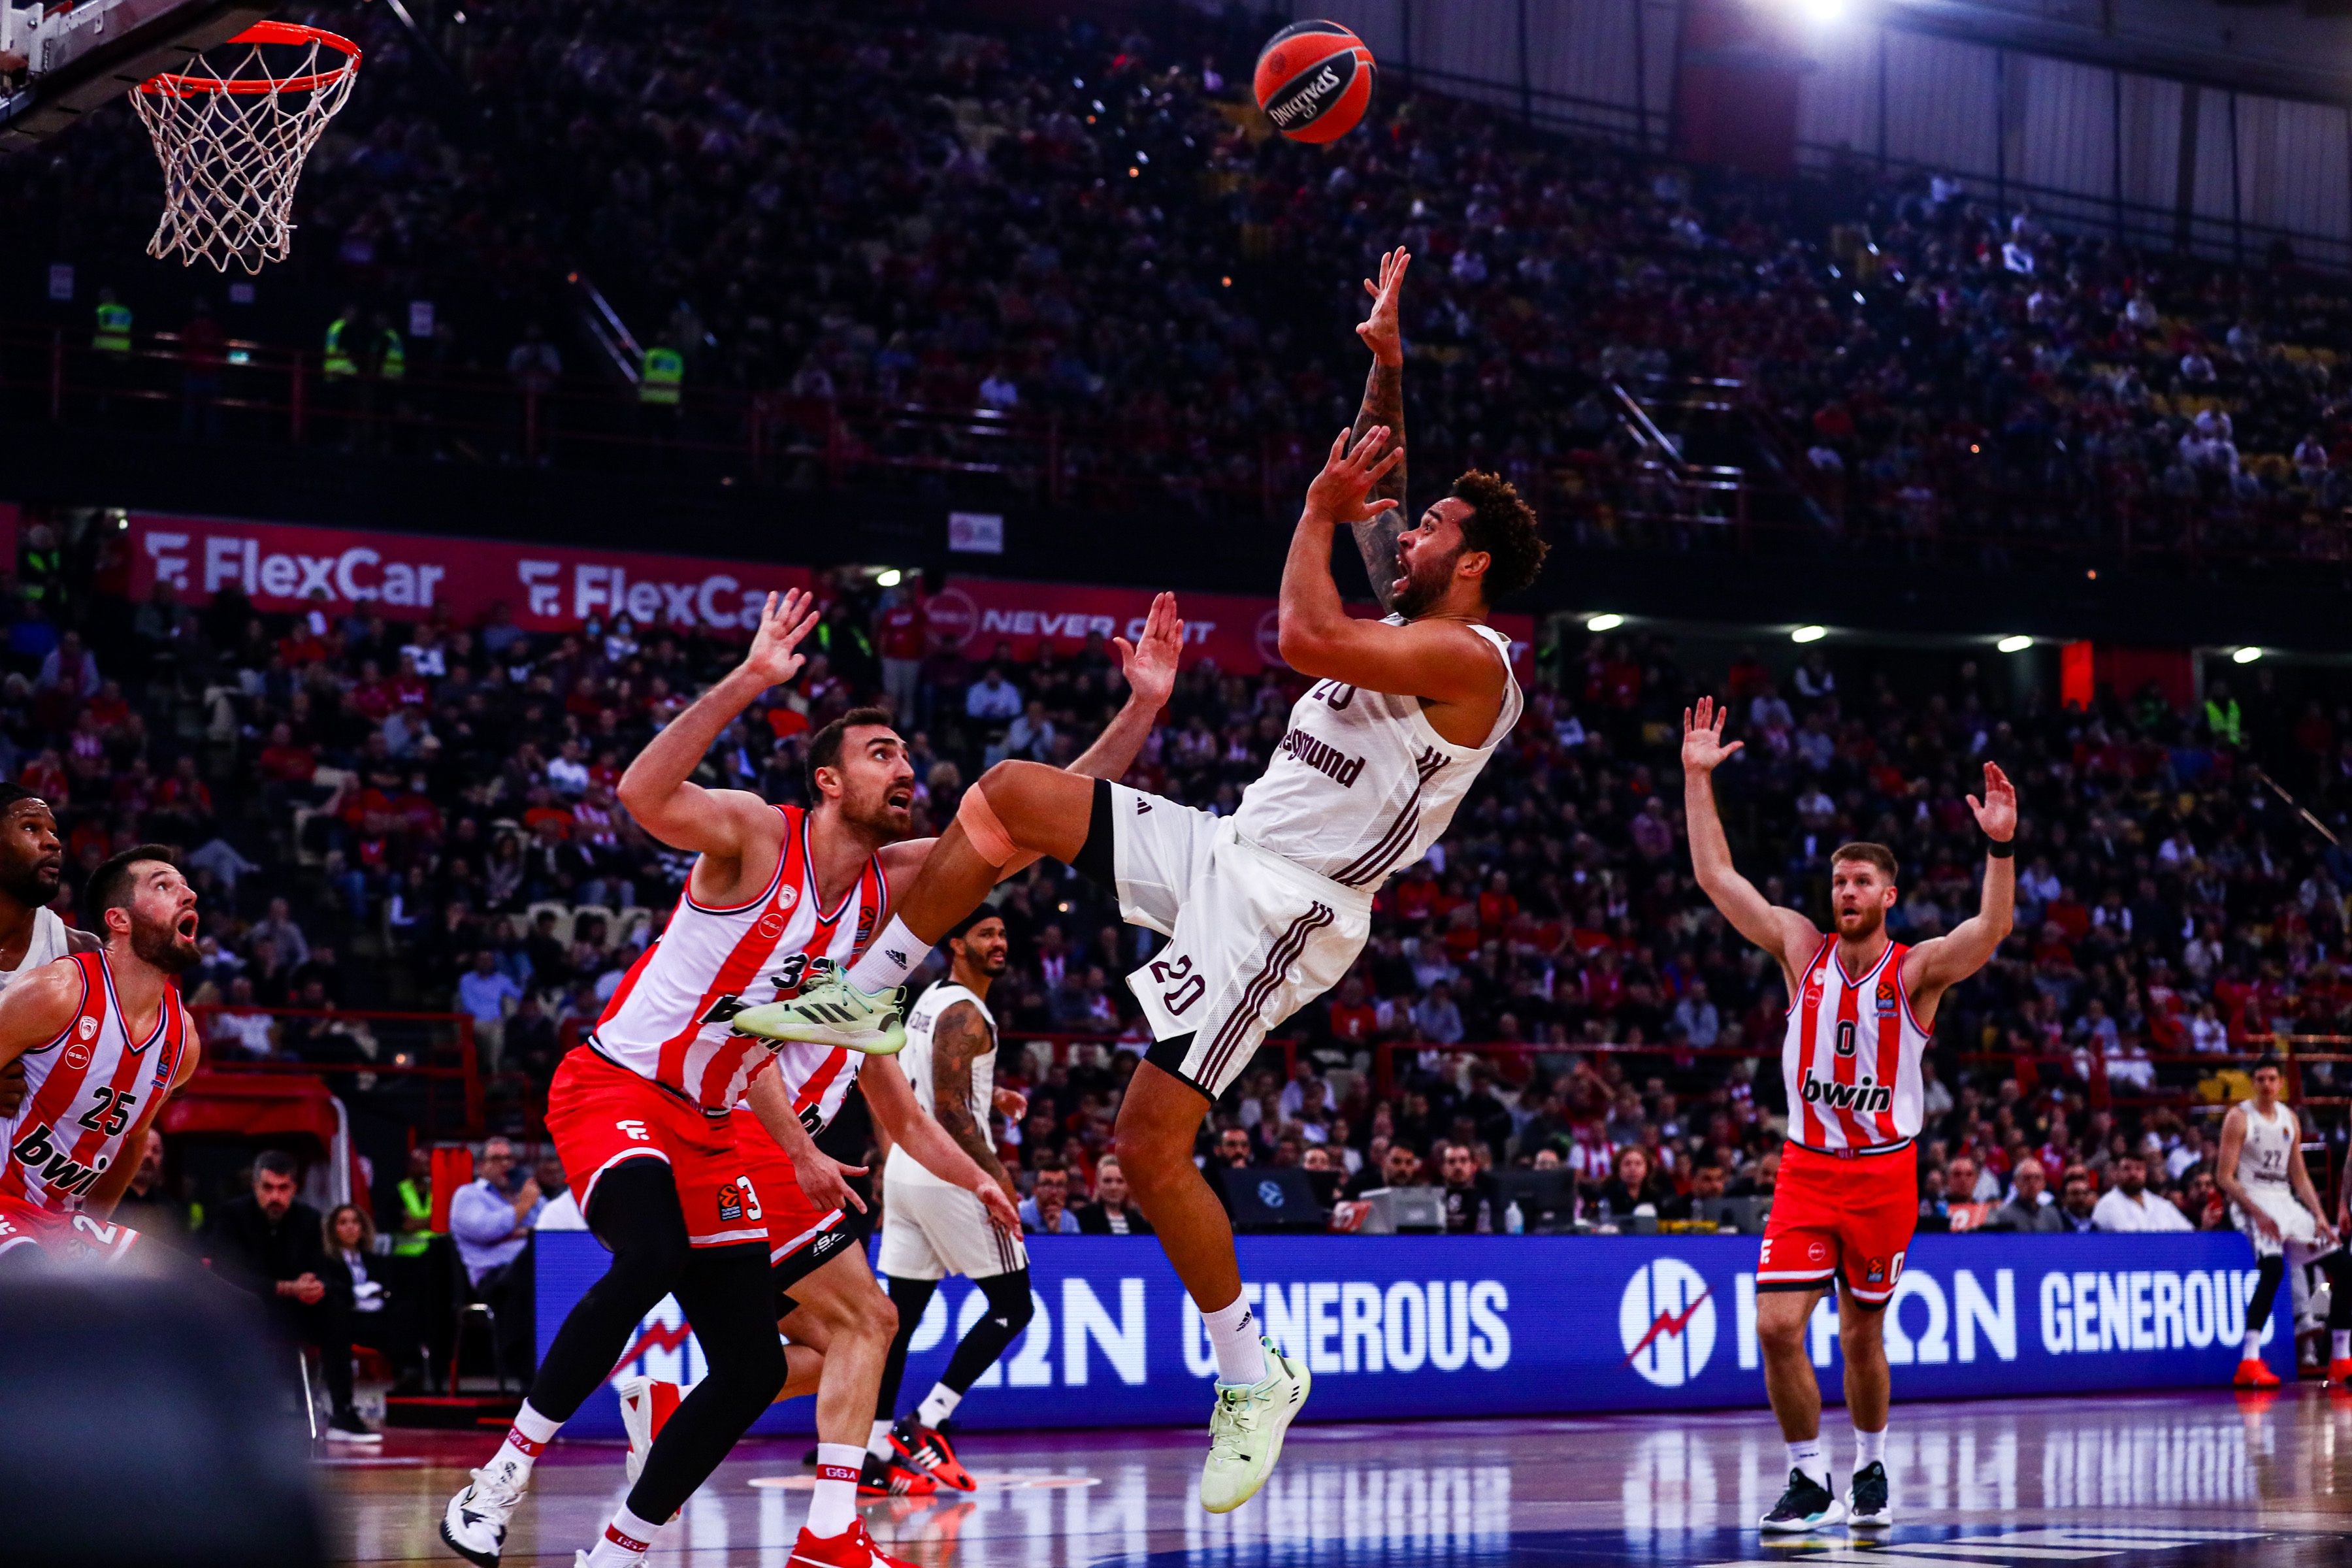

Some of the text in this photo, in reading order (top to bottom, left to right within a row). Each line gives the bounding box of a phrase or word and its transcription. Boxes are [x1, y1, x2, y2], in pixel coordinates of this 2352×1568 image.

[1269, 65, 1340, 127] SPALDING
[204, 536, 444, 606] FlexCar
[574, 564, 777, 630] FlexCa
[983, 609, 1115, 638] NEVER
[1279, 728, 1366, 789] egmund
[885, 950, 908, 970] adidas
[1149, 955, 1205, 1016] 20
[68, 1051, 88, 1061] GSA
[1836, 1019, 1856, 1057] 0
[77, 1086, 137, 1136] 25
[1801, 1068, 1892, 1112] bwin
[13, 1122, 108, 1197] bwi
[736, 1175, 762, 1220] 3
[826, 1467, 856, 1480] GSA
